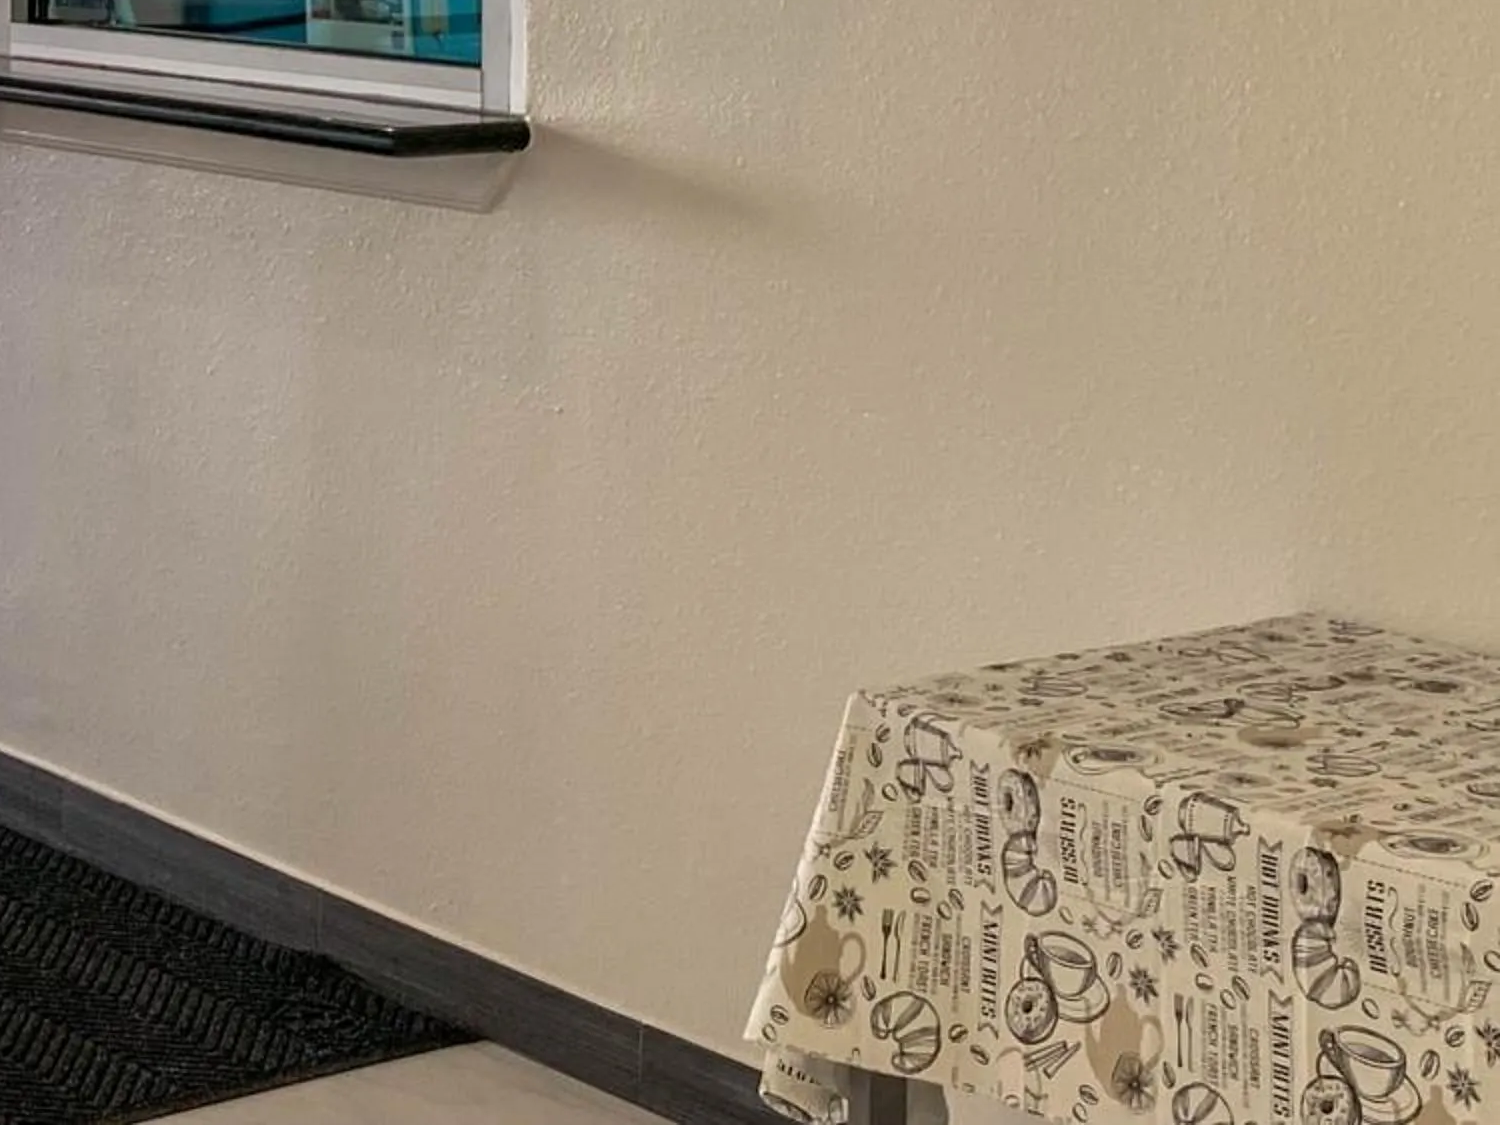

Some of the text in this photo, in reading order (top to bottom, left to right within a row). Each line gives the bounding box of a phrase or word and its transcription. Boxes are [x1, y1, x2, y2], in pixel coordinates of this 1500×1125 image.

[974, 776, 992, 875] HOT DRINKS
[1059, 797, 1078, 884] DESSERTS
[1261, 854, 1280, 964] HOT DRINKS
[1364, 880, 1388, 974] DESSERTS
[981, 922, 999, 1018] MINI BITES
[1272, 1015, 1291, 1118] MINI BITES
